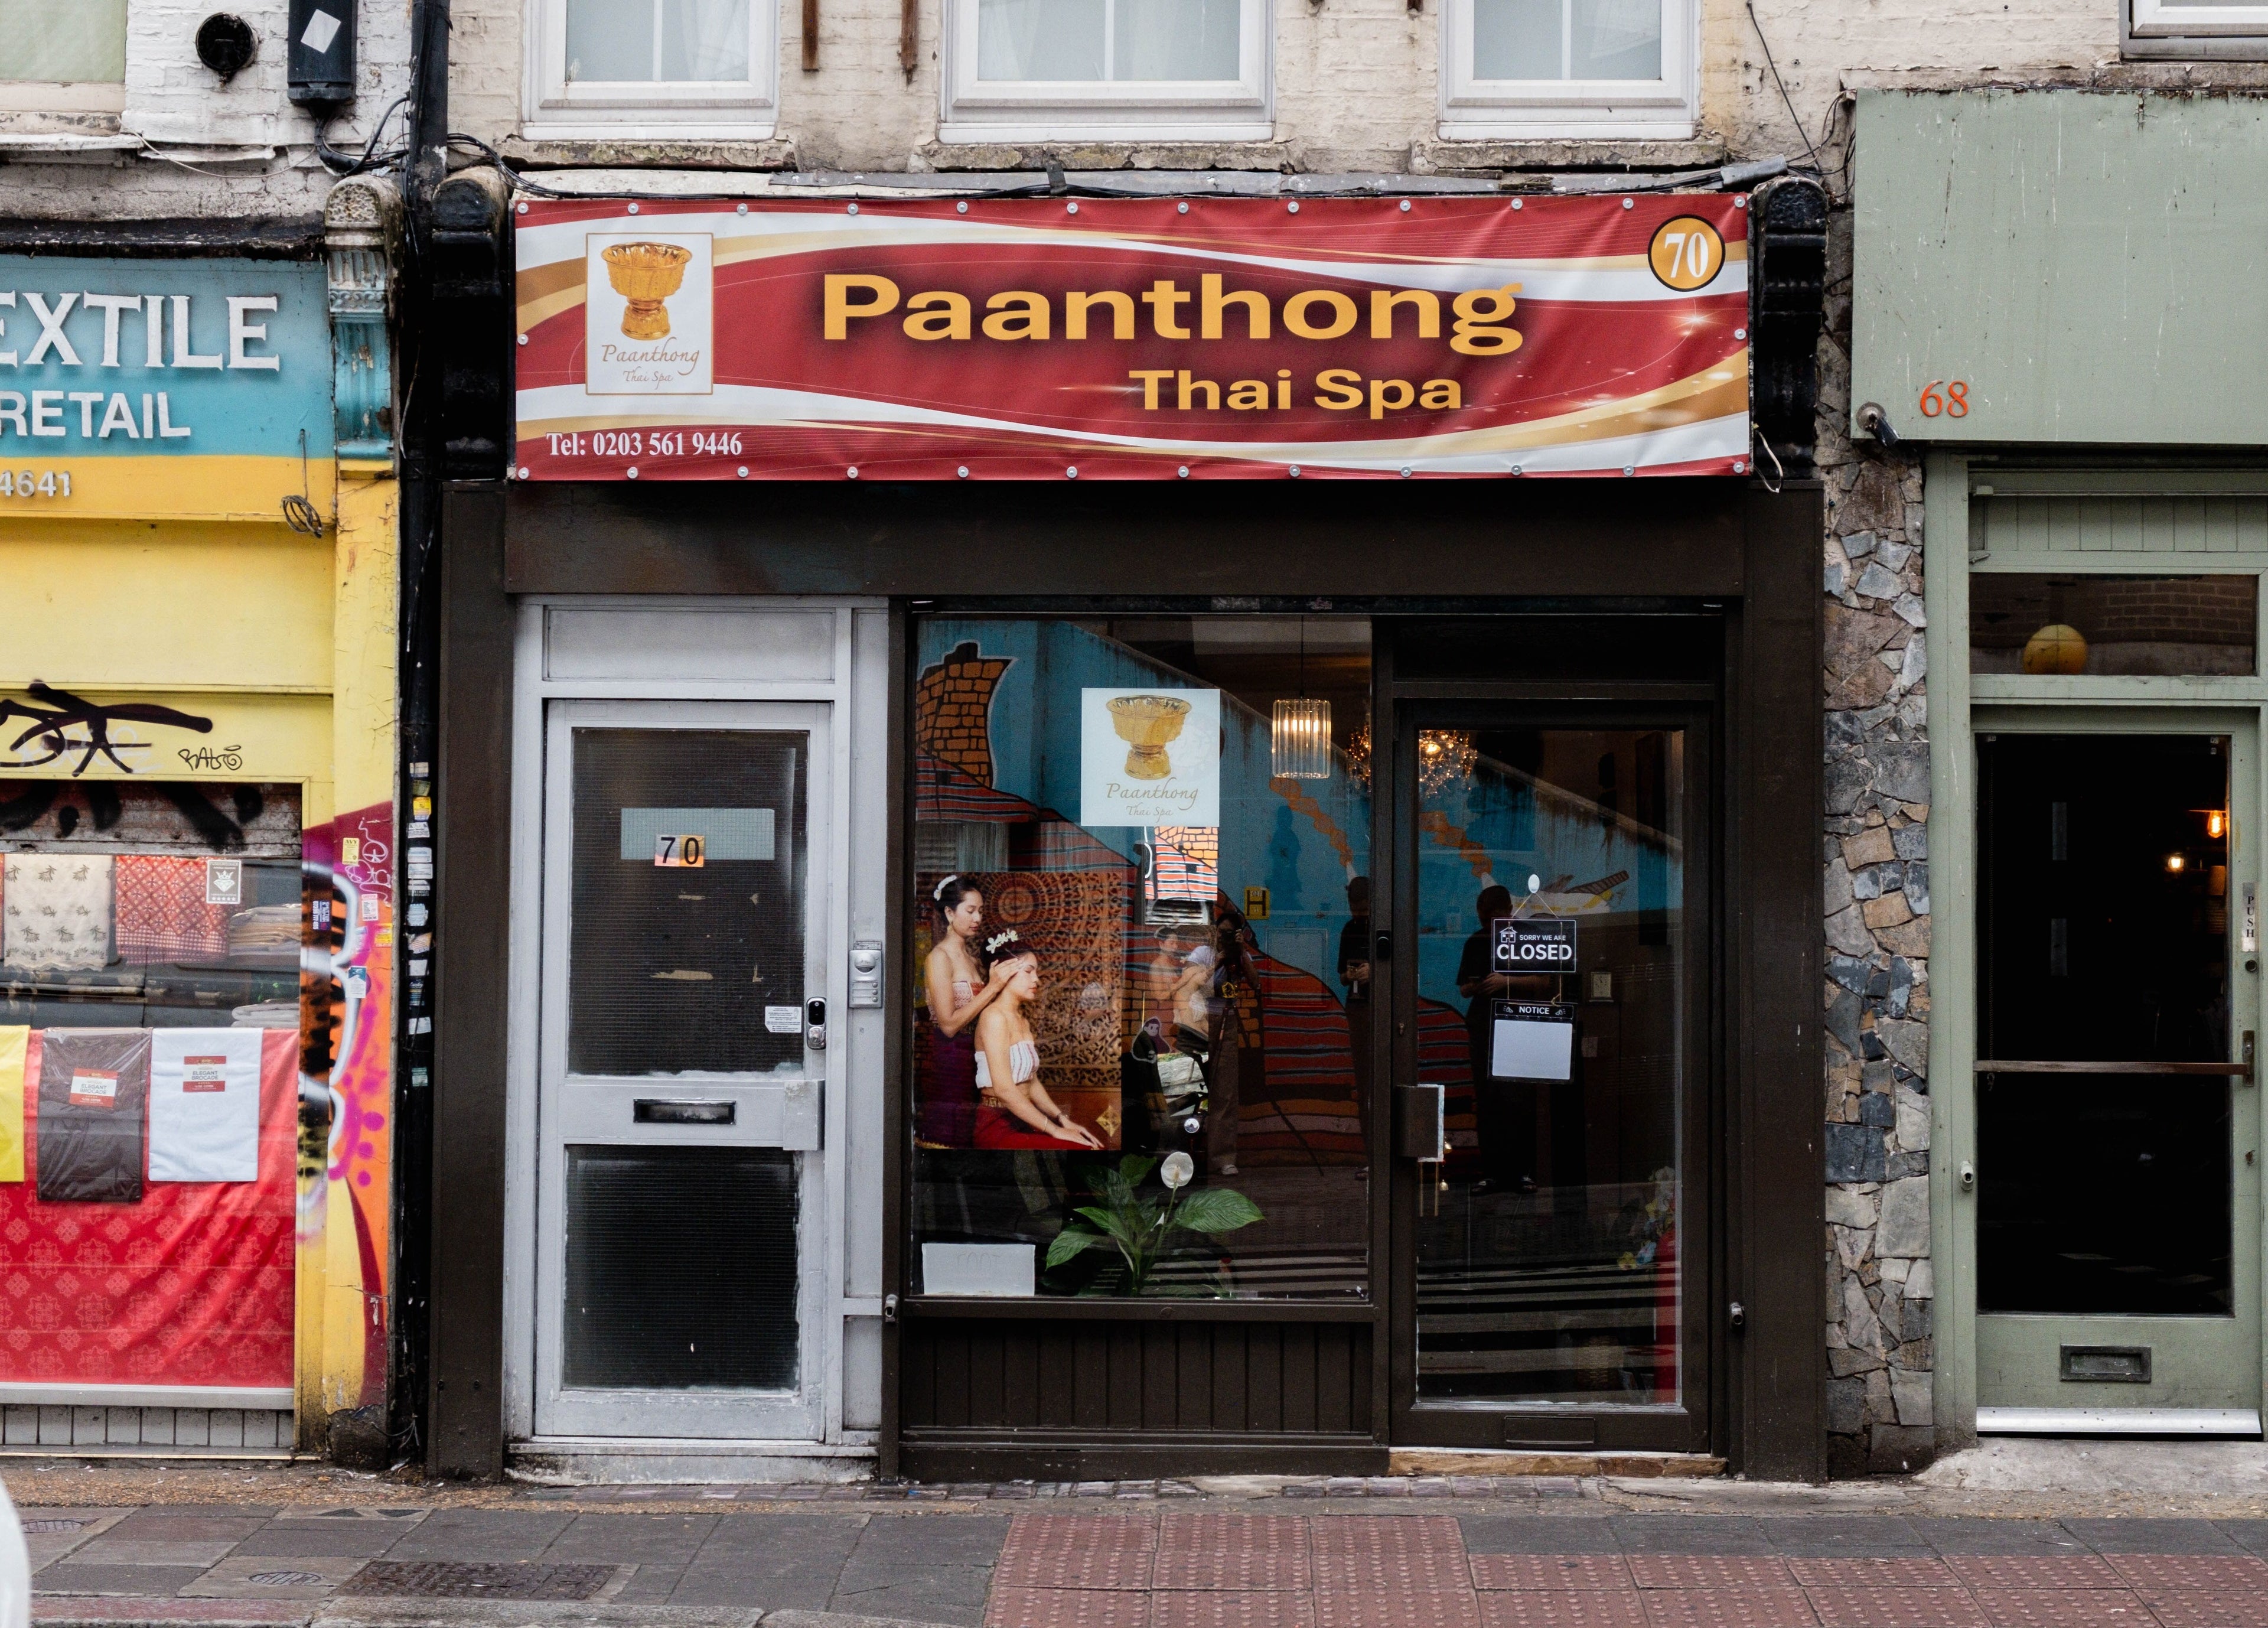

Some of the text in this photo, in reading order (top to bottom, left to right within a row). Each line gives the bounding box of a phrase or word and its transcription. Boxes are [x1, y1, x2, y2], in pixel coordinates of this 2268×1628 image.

[1664, 232, 1709, 278] 70
[824, 273, 1523, 356] Paanthong
[601, 336, 700, 376] Paanthong
[623, 366, 673, 390] Thai Spa
[1129, 369, 1461, 419] Thai Spa
[0, 390, 191, 438] RETAIL
[1920, 380, 1969, 418] 68
[546, 432, 742, 455] Tel: 0203 561 9446
[1106, 777, 1198, 811] Paanthong
[1126, 802, 1174, 823] Thai Spa
[660, 836, 699, 865] 70
[2246, 896, 2255, 937] PUSH
[1497, 944, 1572, 960] CLOSED
[1519, 1006, 1550, 1014] NOTICE
